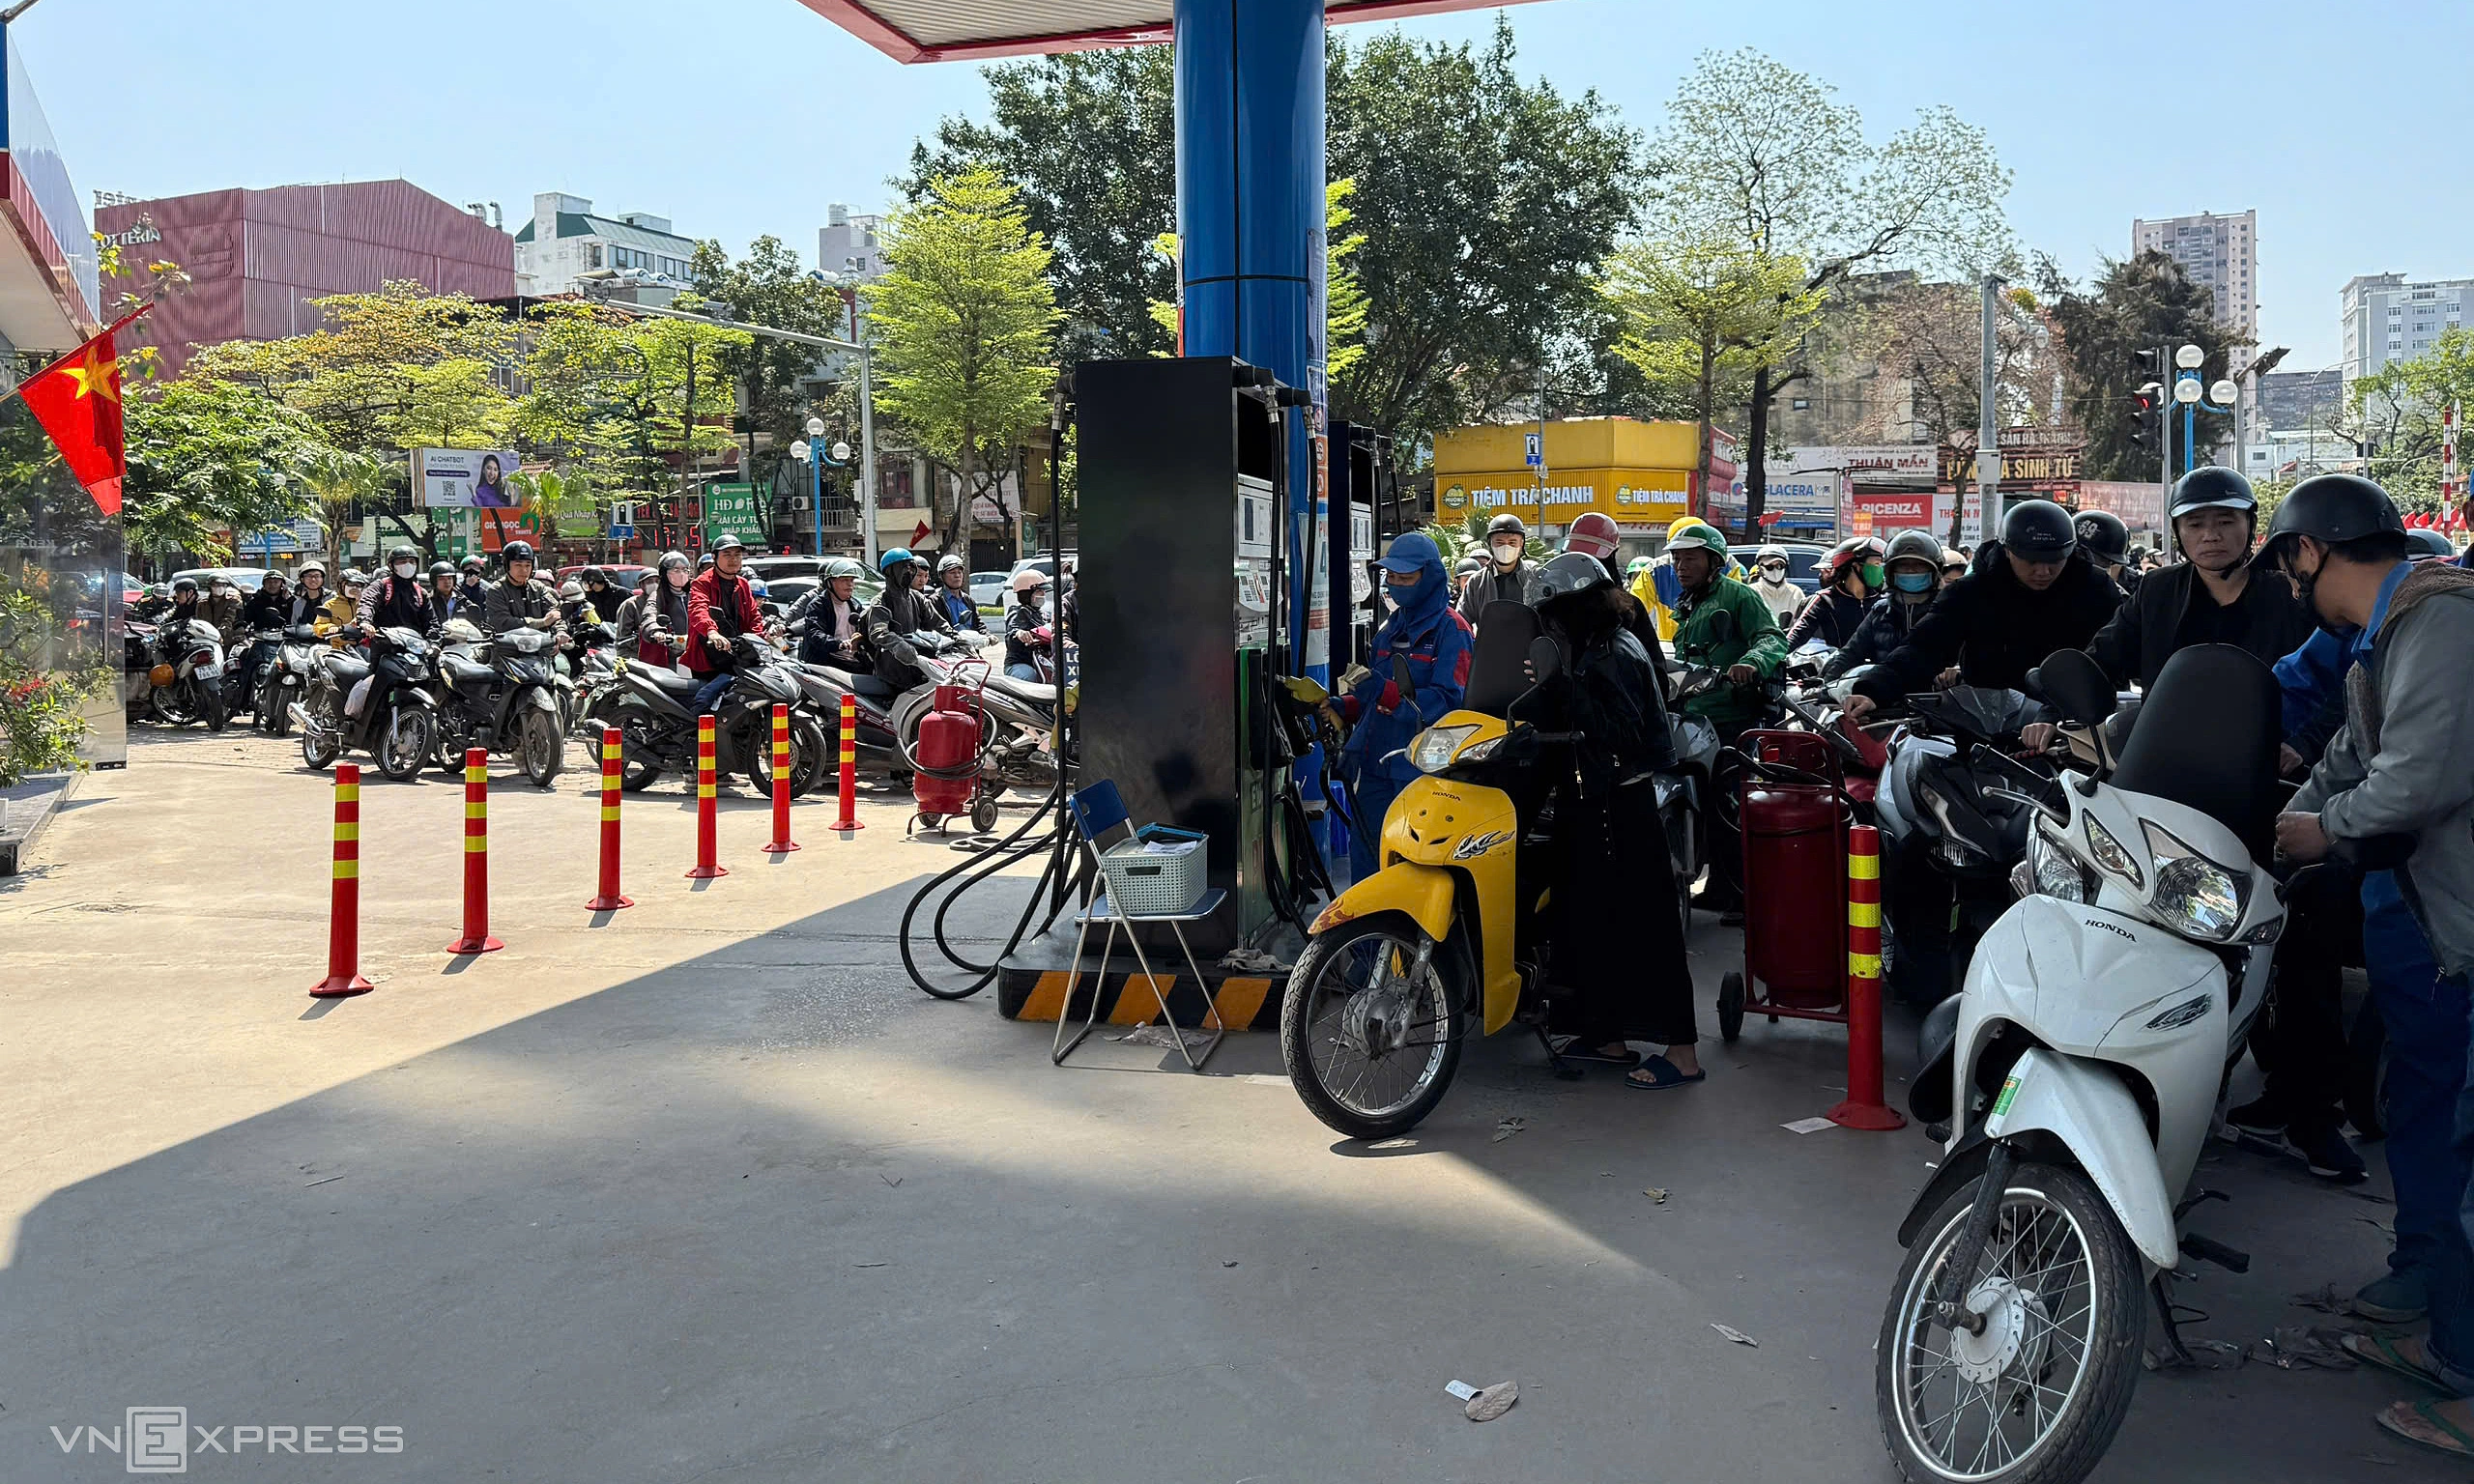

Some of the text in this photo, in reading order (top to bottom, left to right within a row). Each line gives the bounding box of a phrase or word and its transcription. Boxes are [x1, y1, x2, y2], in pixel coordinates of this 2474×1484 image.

[99, 227, 161, 248] OTTERIA
[438, 455, 465, 464] CHATBOT
[2014, 458, 2050, 479] SINH
[1542, 485, 1594, 504] CHANH
[1664, 490, 1688, 503] CHANH
[1431, 790, 1461, 802] HONDA
[2085, 919, 2138, 944] HONDA
